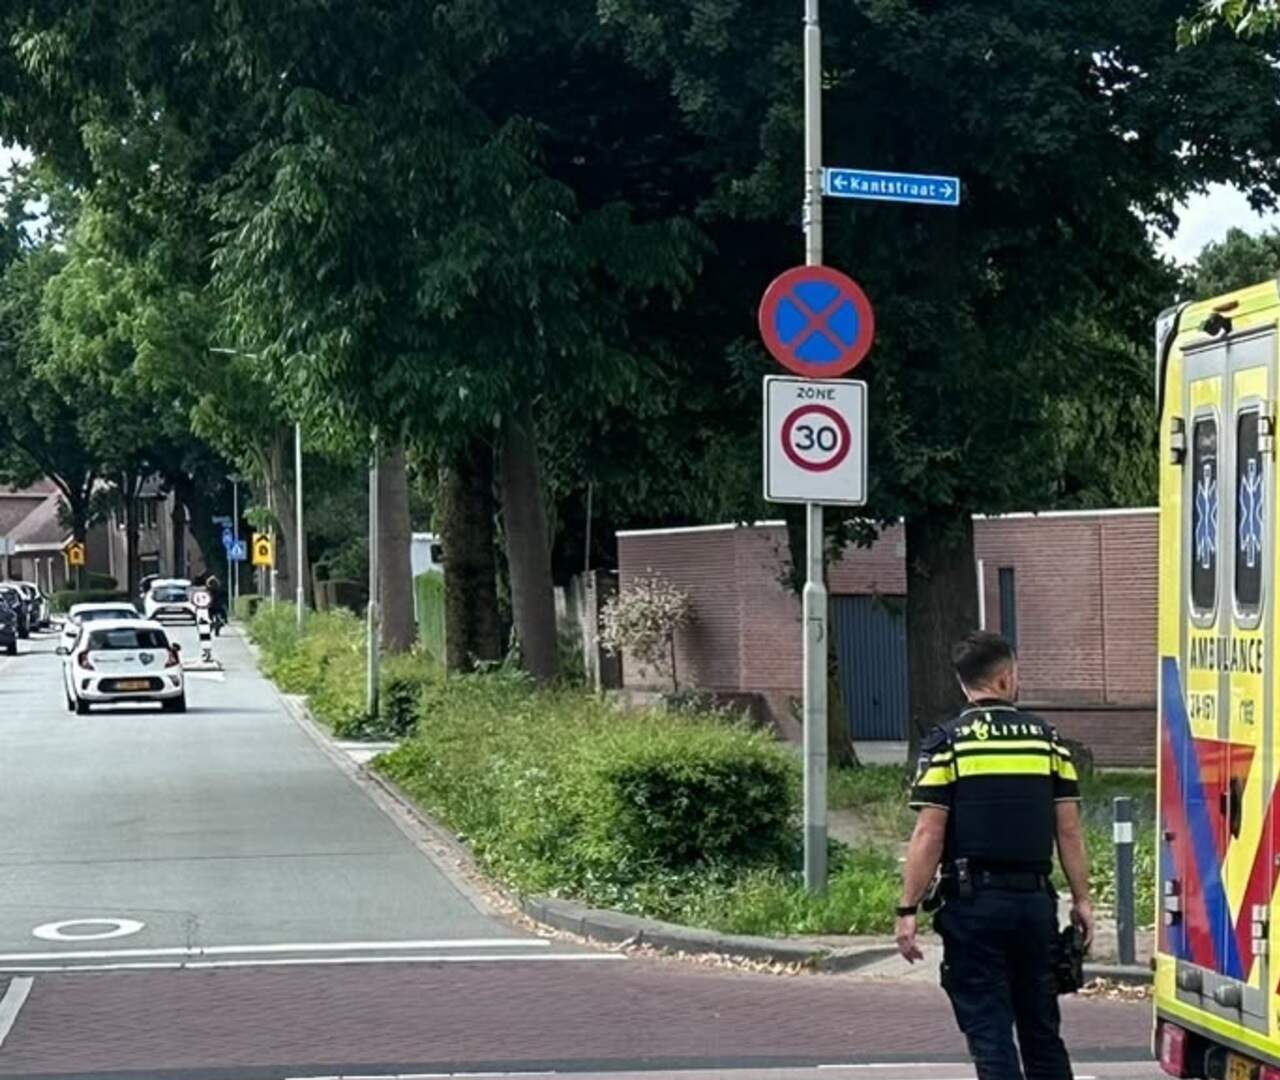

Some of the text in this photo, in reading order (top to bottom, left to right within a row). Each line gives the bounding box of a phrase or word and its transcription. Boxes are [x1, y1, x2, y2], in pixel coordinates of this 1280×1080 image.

[850, 176, 936, 196] Kantstraat
[796, 387, 836, 401] ZONE
[795, 425, 838, 452] 30
[1190, 637, 1263, 674] AMBULANCE
[961, 723, 1039, 738] PLITIE
